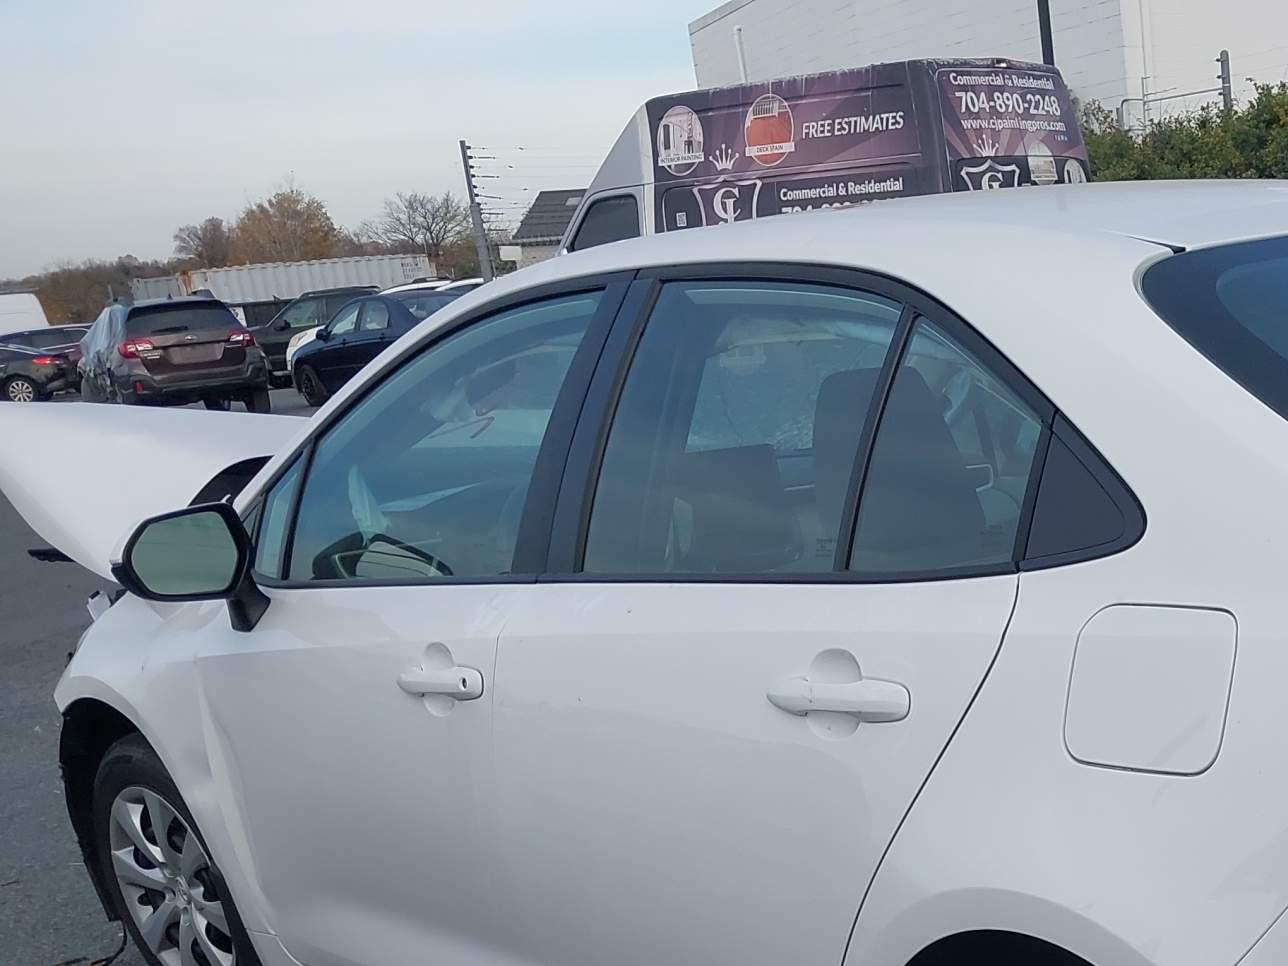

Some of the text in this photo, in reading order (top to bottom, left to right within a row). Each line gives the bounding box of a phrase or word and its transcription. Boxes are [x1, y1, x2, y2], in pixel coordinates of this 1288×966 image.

[950, 72, 1054, 90] Commercial & Residential
[955, 91, 1061, 116] 704-890-2248
[802, 112, 904, 139] FREE ESTIMATES
[780, 177, 904, 201] Commercial & Residential
